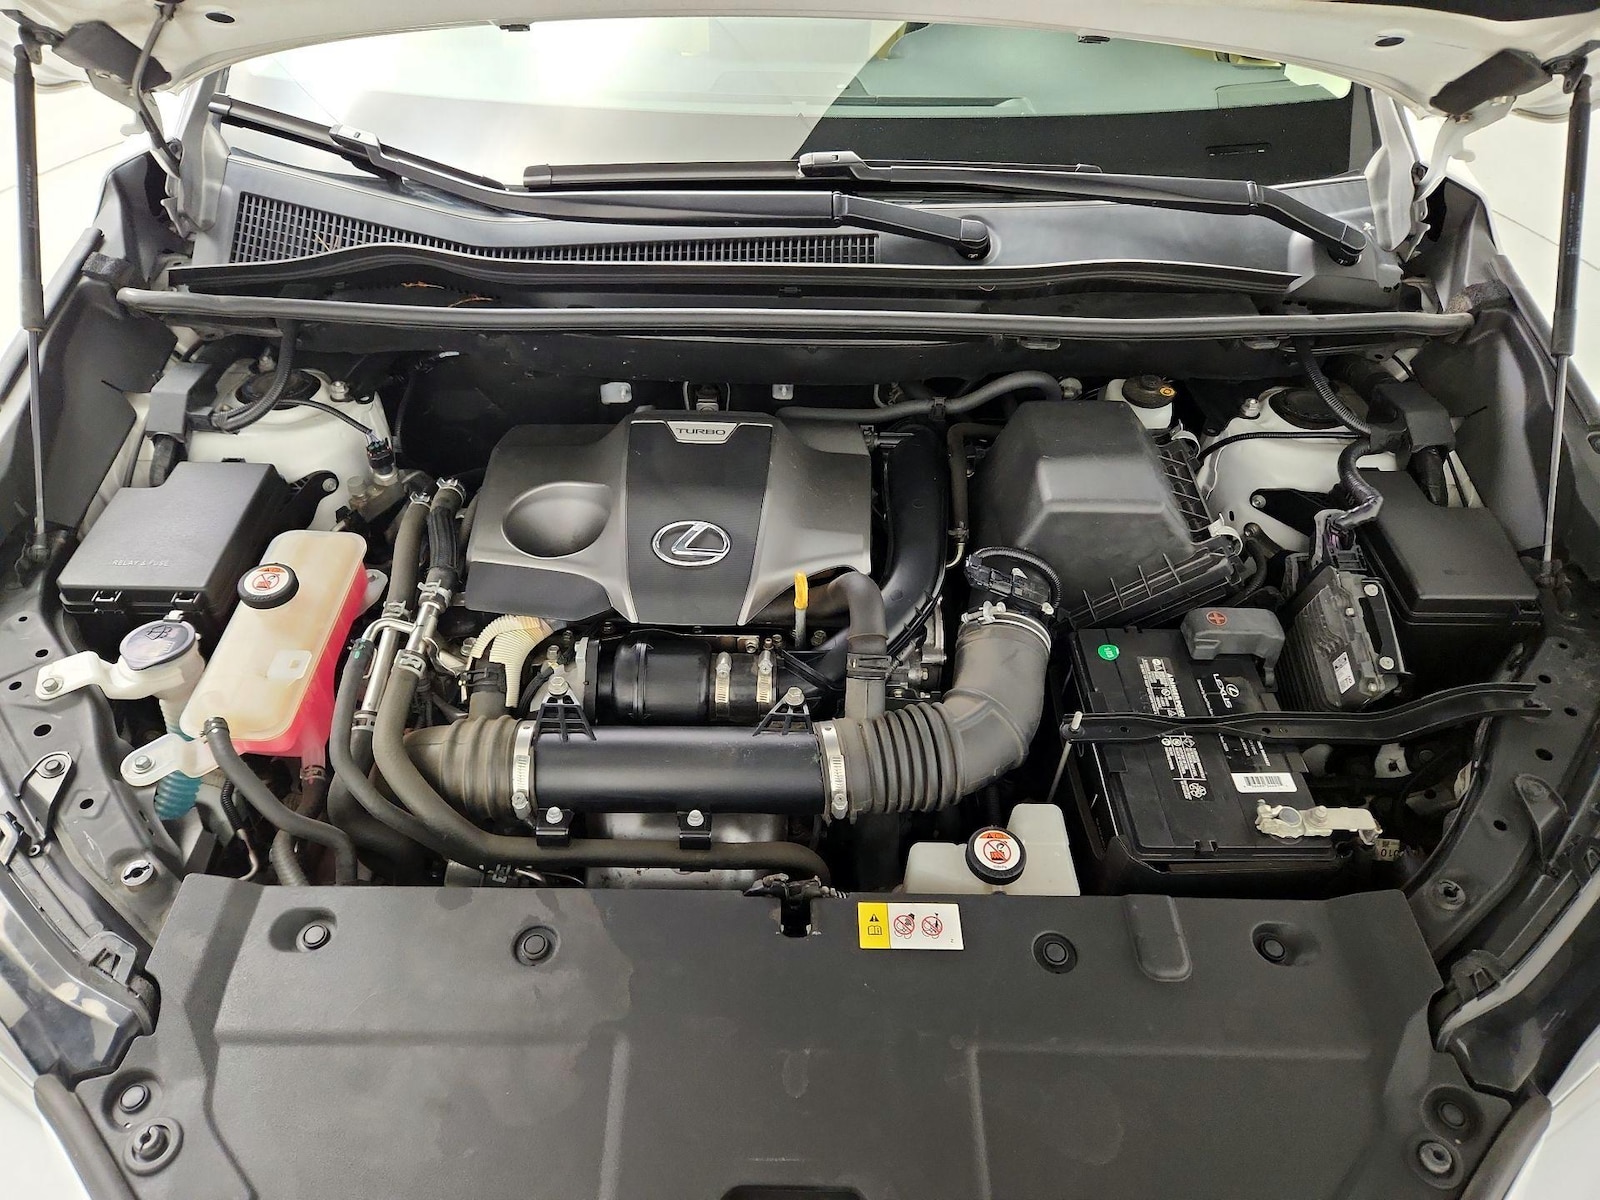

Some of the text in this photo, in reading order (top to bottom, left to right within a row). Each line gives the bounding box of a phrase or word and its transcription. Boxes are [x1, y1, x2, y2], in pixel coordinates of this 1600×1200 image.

[675, 427, 726, 436] TURBO
[148, 560, 169, 568] FUSE
[1212, 673, 1233, 709] LEXUS
